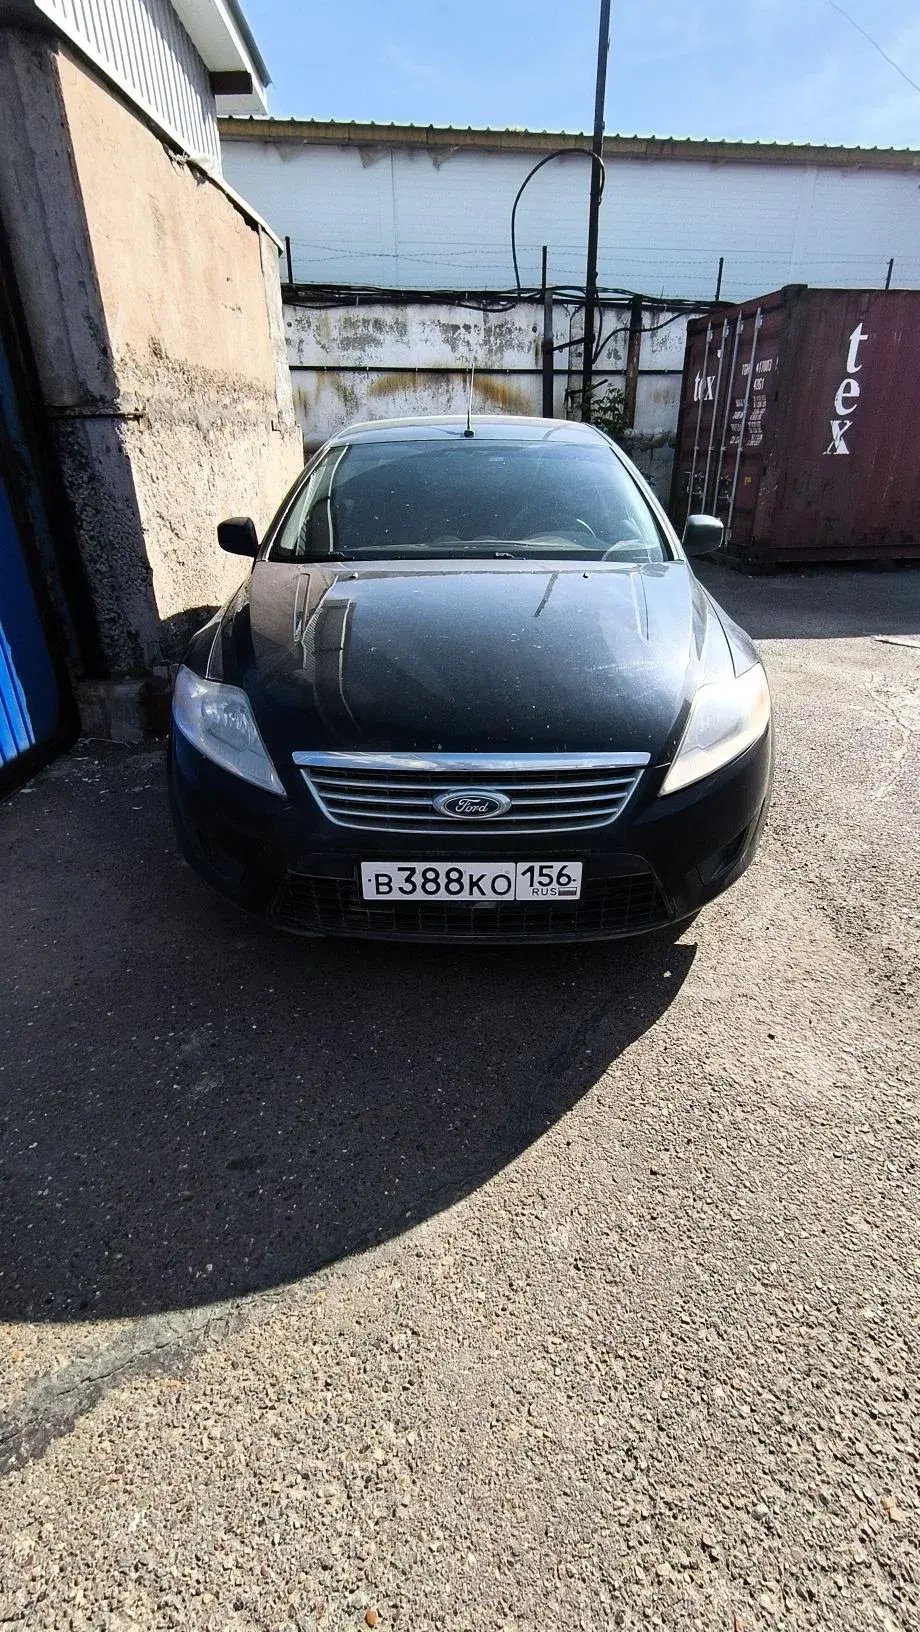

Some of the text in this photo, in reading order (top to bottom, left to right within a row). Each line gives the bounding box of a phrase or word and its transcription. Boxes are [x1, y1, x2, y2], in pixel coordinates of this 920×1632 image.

[822, 322, 869, 455] tex
[455, 798, 489, 814] Ford
[374, 865, 573, 895] В388КО 156
[532, 887, 557, 896] RUS
